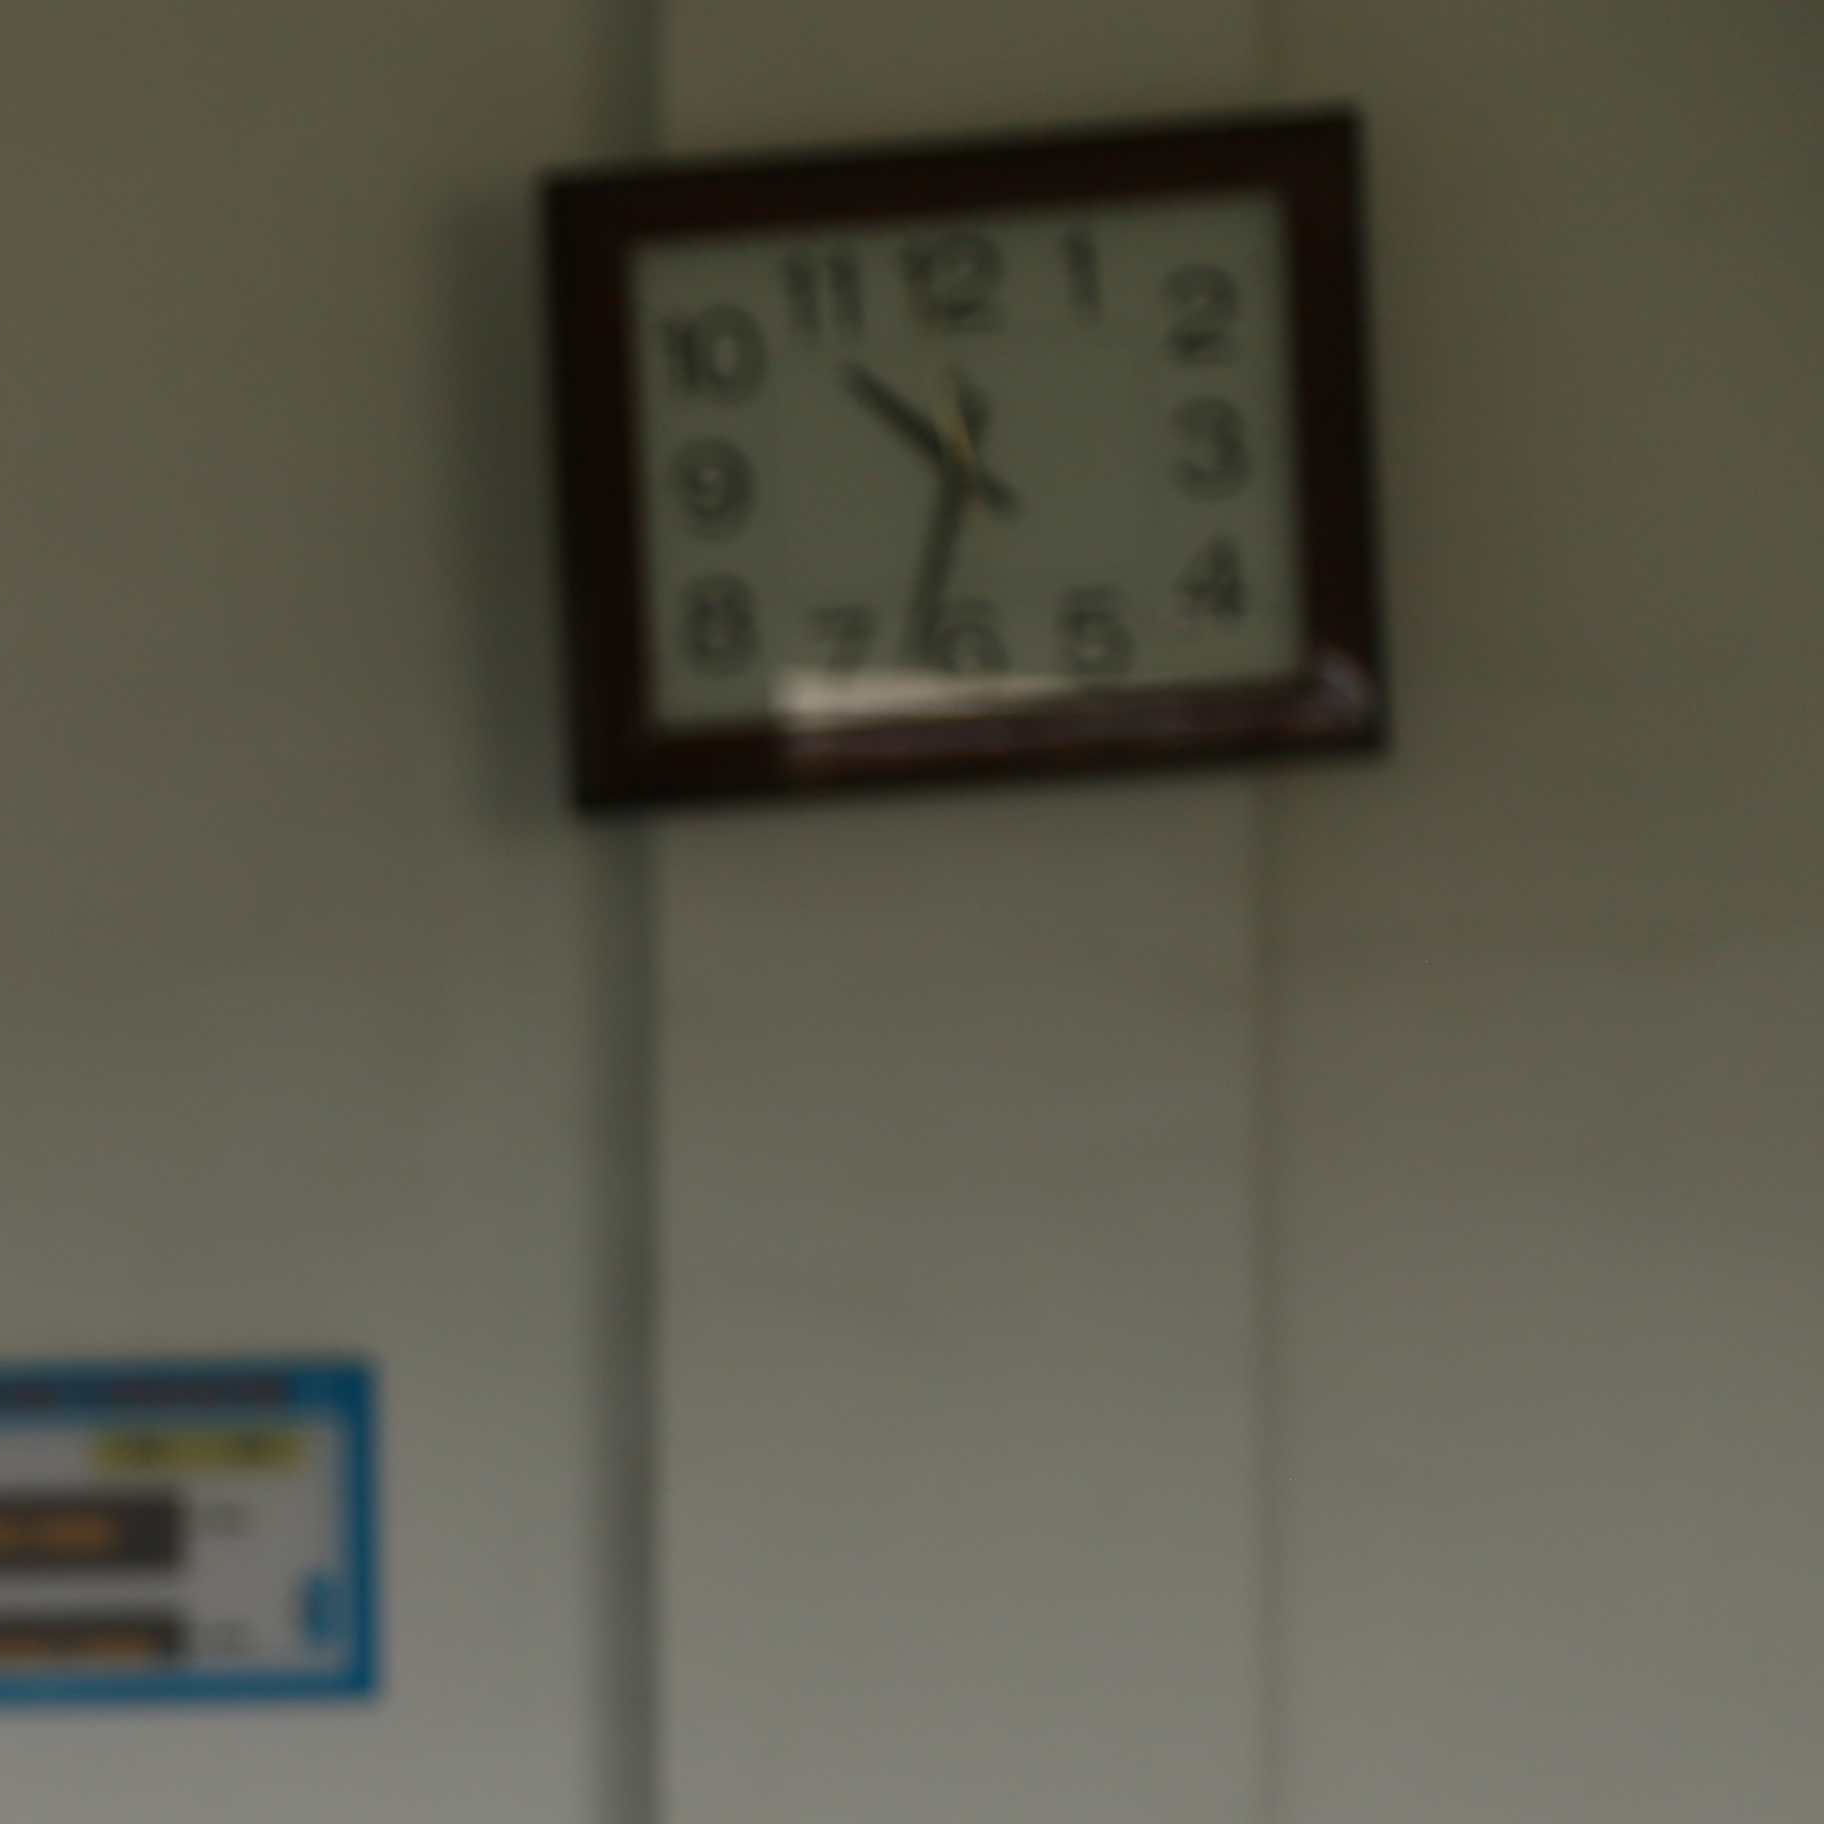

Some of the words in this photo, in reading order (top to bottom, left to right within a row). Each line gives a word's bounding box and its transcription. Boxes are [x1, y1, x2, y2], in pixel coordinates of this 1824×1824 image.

[787, 247, 863, 336] 11
[902, 230, 1005, 332] 12
[1063, 222, 1101, 321] 1
[1164, 262, 1239, 365] 2
[662, 304, 763, 402] 10
[671, 438, 752, 539] 9
[1172, 396, 1251, 499] 3
[681, 572, 759, 677] 8
[1175, 536, 1246, 622] 4
[1056, 585, 1133, 674] 5
